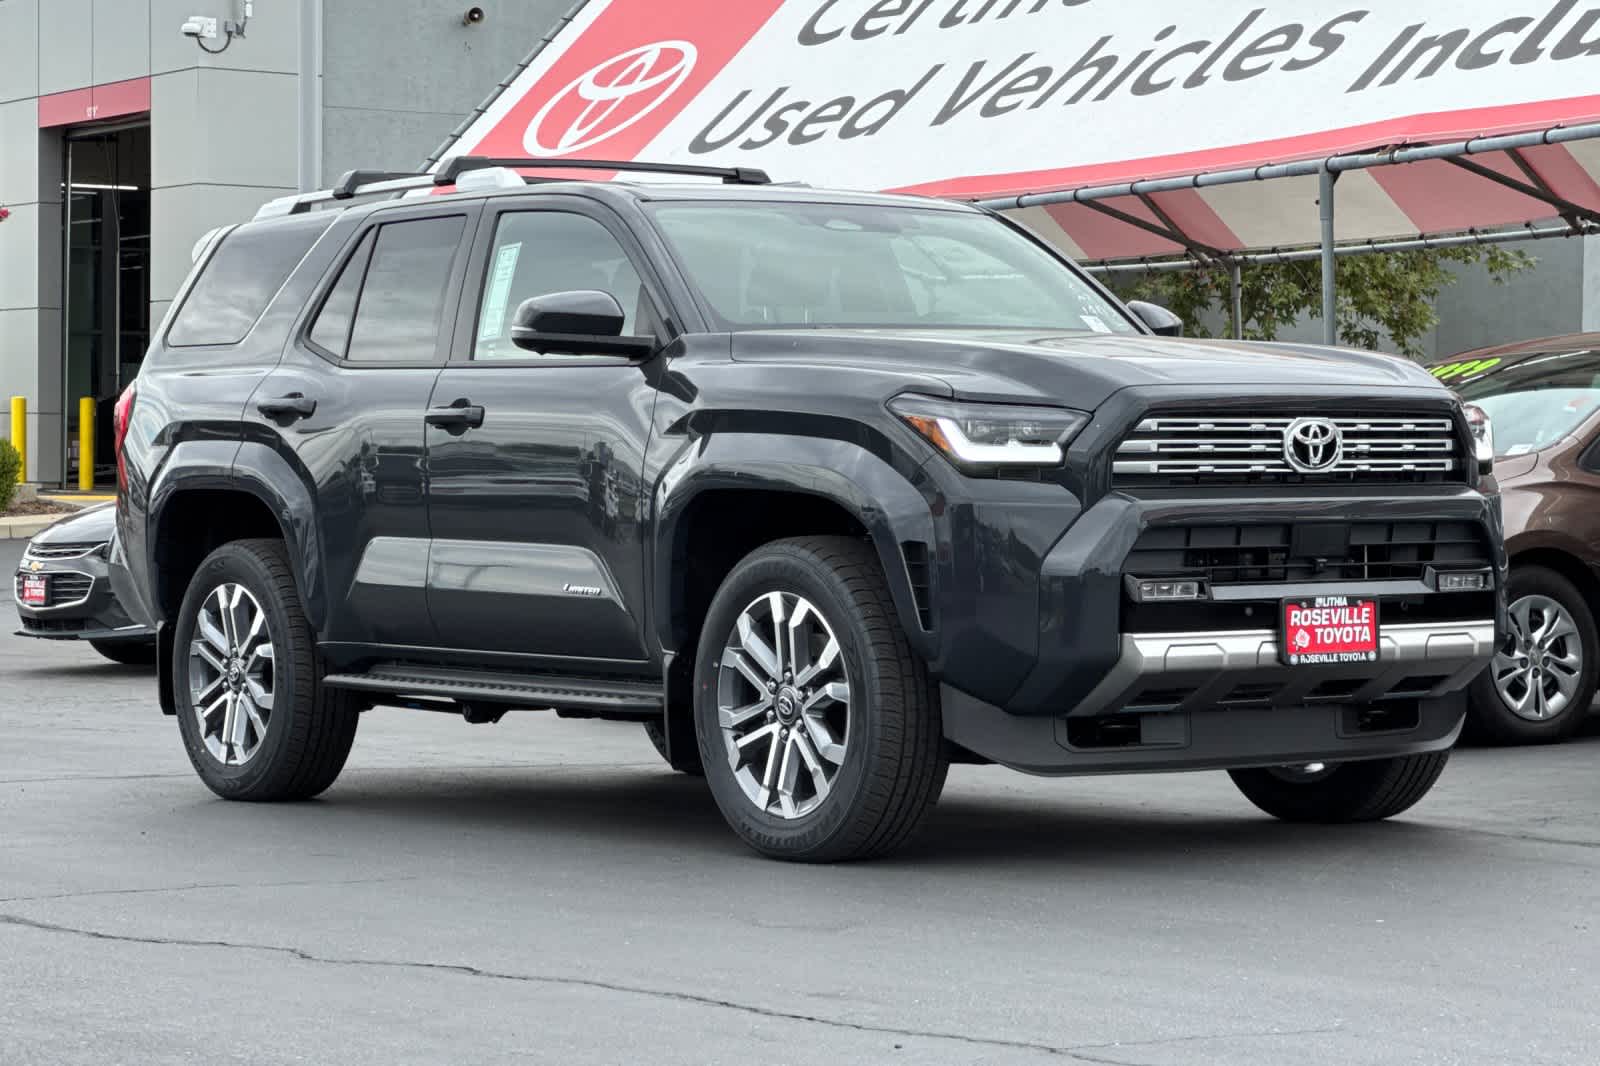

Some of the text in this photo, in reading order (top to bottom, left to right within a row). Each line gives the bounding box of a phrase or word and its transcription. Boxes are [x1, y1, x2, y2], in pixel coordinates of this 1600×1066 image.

[688, 63, 946, 155] Used
[929, 8, 1370, 127] Vehicles
[1290, 607, 1371, 626] ROSEVILLE
[1314, 626, 1371, 644] TOYOTA
[1340, 651, 1367, 663] TOYOTA
